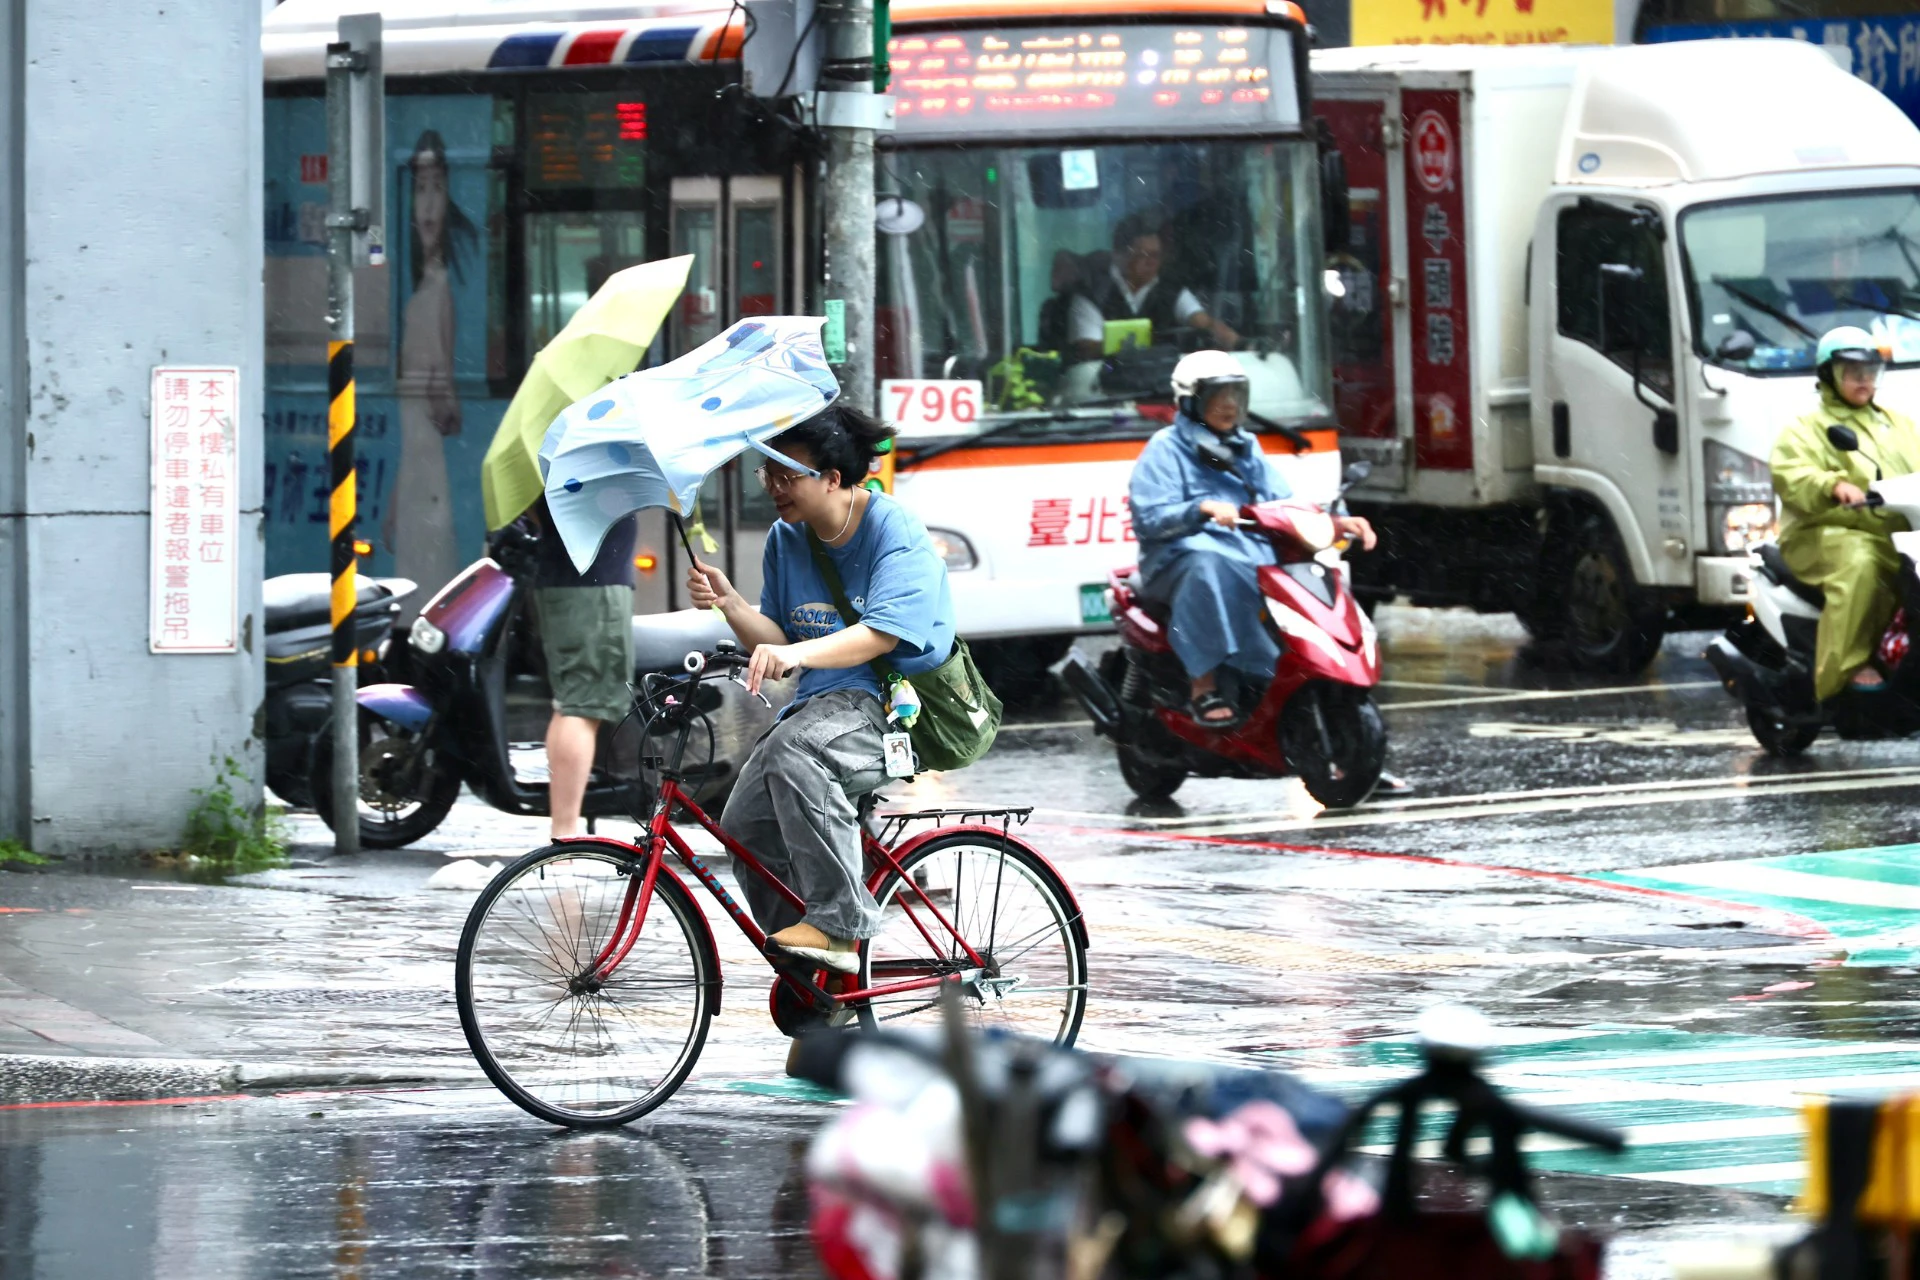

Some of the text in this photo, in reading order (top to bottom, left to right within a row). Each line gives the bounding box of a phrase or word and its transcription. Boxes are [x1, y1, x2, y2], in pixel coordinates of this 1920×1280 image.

[199, 378, 226, 563] 本大樓私有車位
[890, 385, 976, 424] 796
[163, 377, 191, 641] 請勿停車違者報警拖吊
